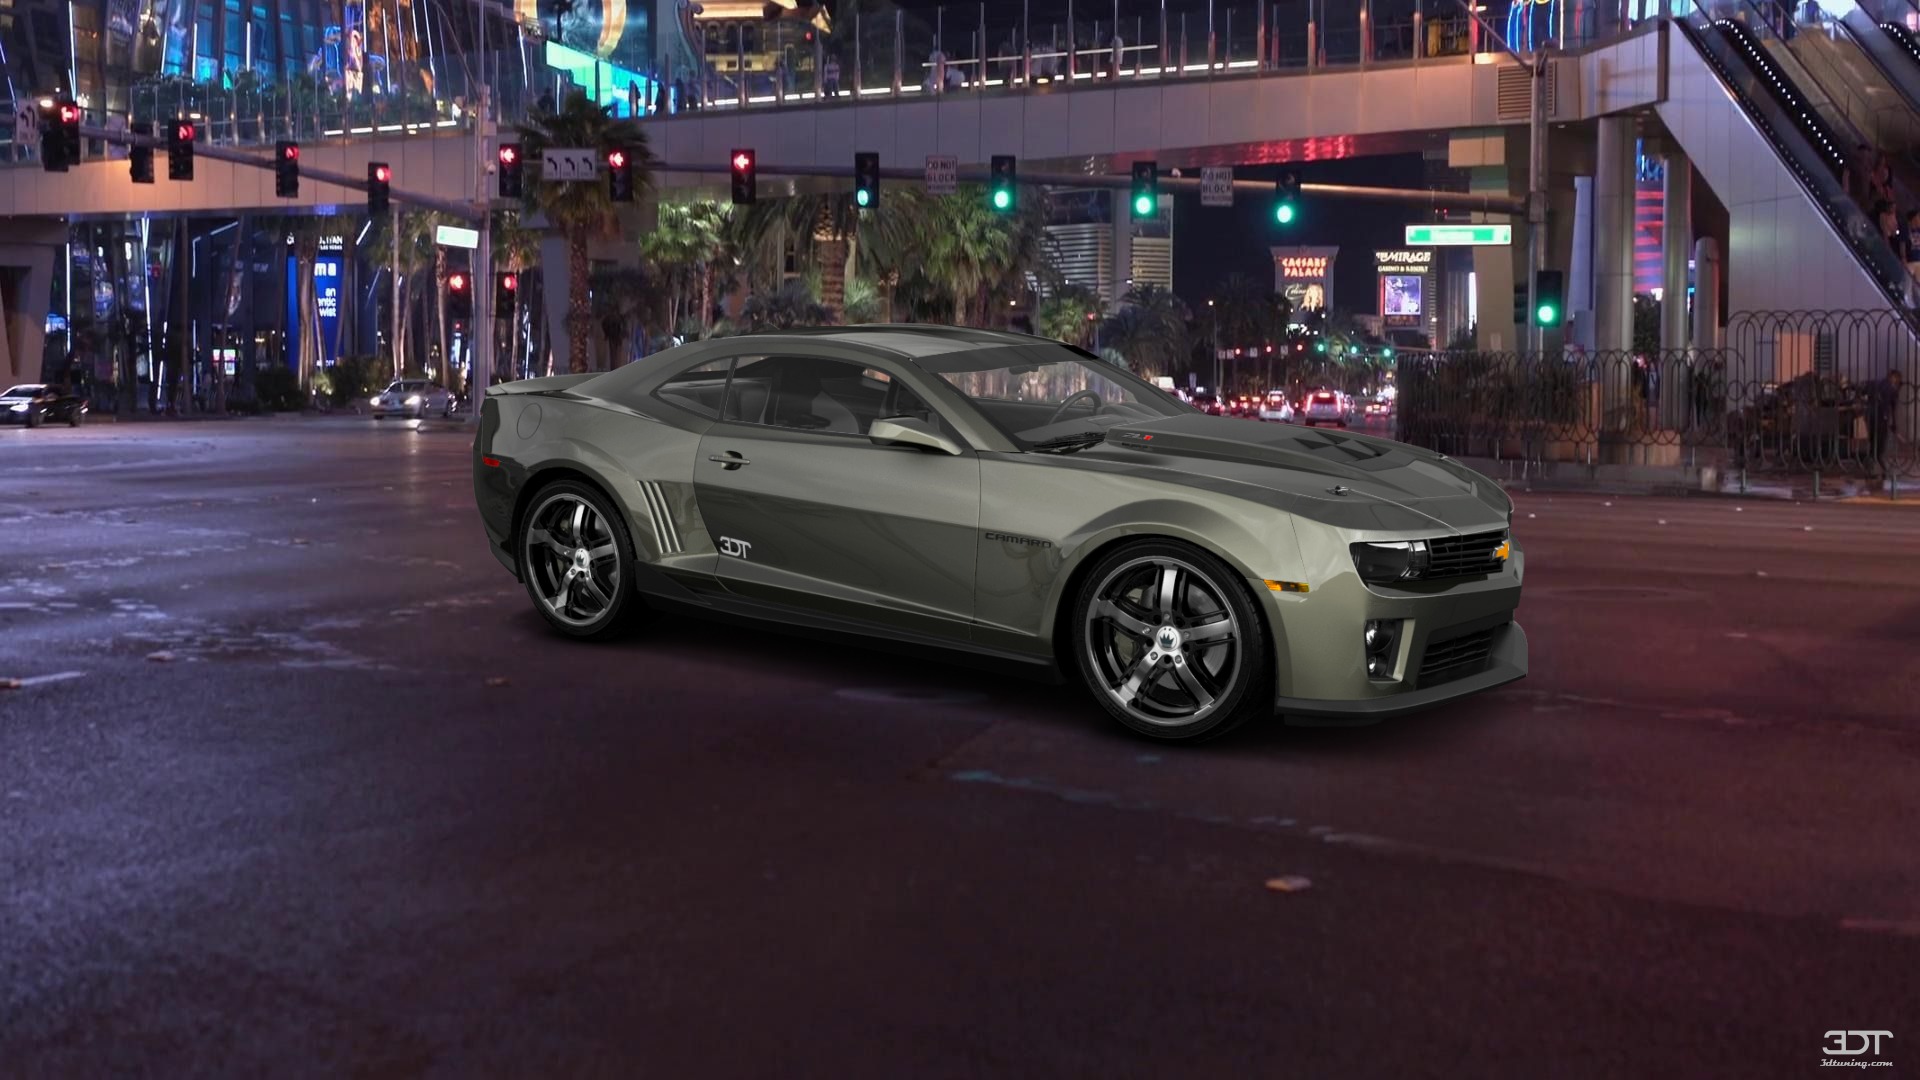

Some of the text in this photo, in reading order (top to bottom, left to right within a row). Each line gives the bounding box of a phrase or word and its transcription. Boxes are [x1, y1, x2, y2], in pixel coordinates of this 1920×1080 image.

[928, 160, 955, 169] DO NOT
[927, 174, 955, 182] BLOCK
[1216, 171, 1230, 180] NOT
[1203, 184, 1231, 192] BLOCK
[1281, 257, 1326, 267] CAESARS
[1388, 252, 1431, 263] MIRAGE
[1284, 267, 1324, 277] PALACE
[985, 532, 1052, 549] CAMARO
[720, 536, 752, 559] 3DT
